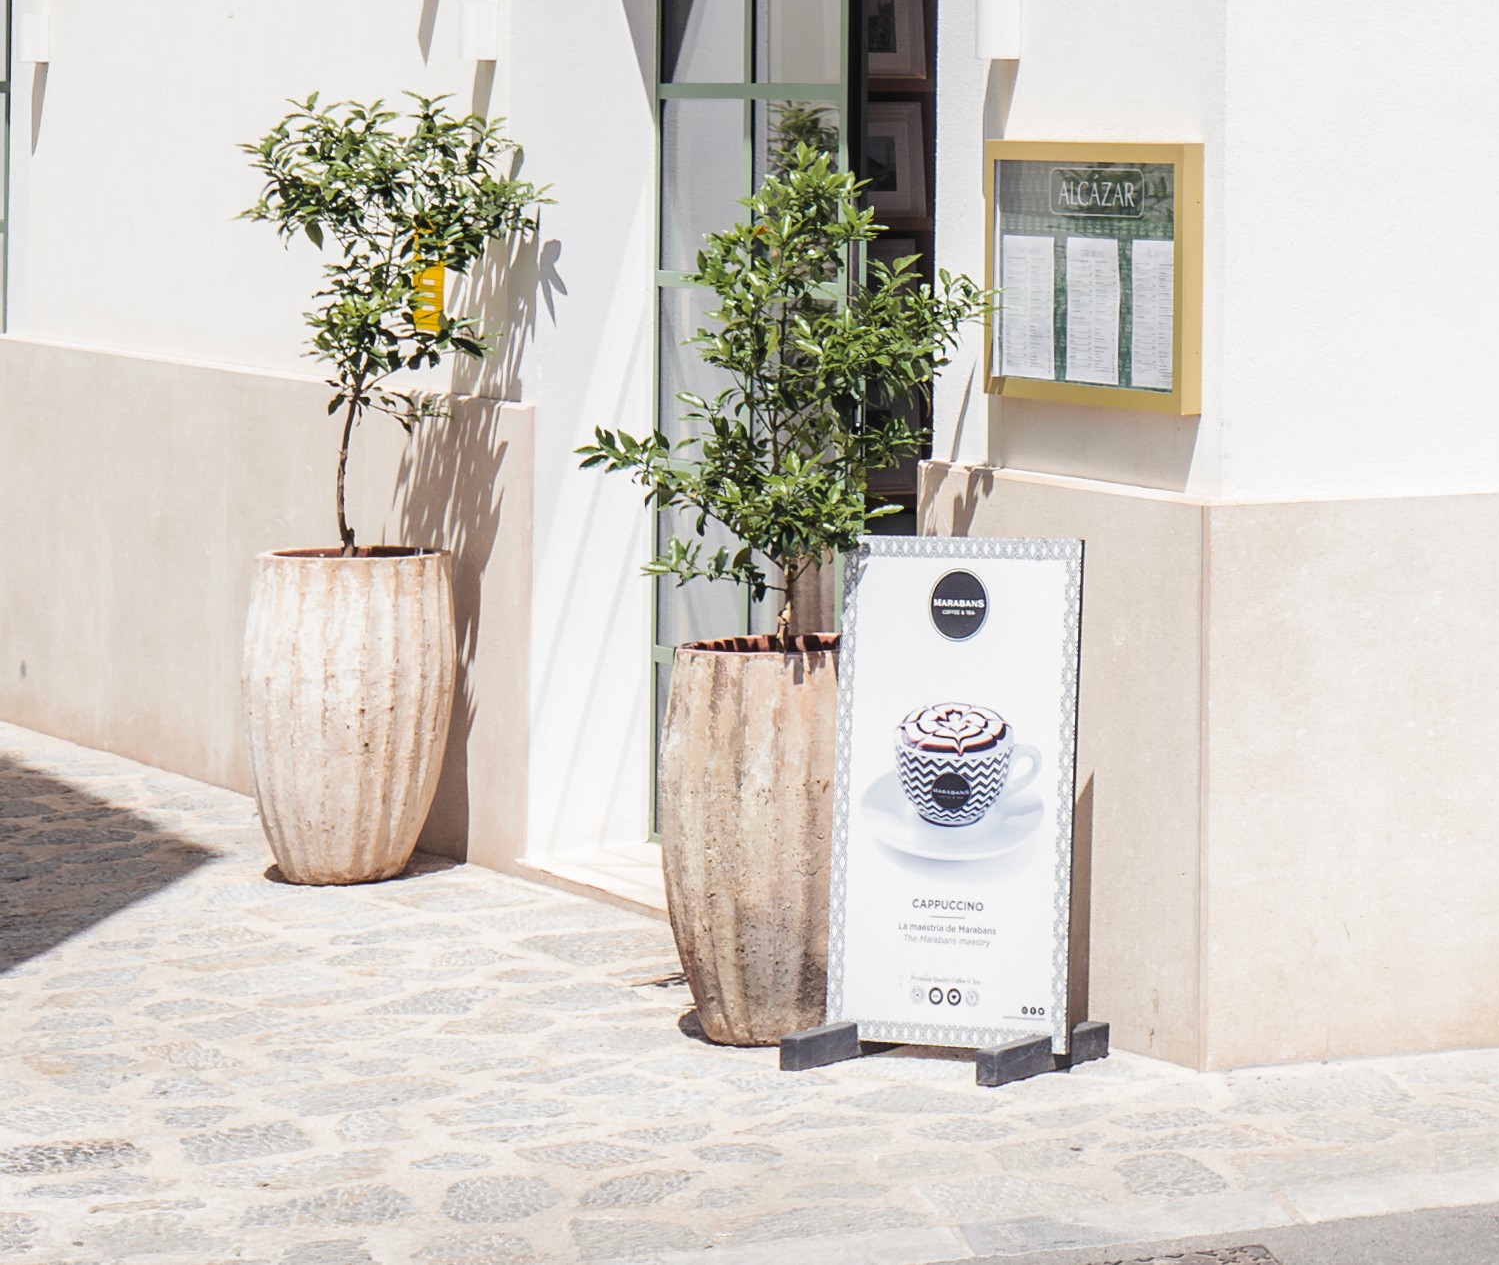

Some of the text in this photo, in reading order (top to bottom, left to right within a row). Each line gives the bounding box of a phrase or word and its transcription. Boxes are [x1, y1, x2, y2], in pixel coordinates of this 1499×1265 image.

[1057, 174, 1135, 208] ALCÁZAR
[933, 598, 985, 608] MARABANS
[911, 898, 985, 912] CAPPUCCINO
[898, 922, 908, 930] La
[946, 924, 956, 933] de
[958, 925, 997, 936] Marabans
[903, 933, 991, 947] The Marabans maestry
